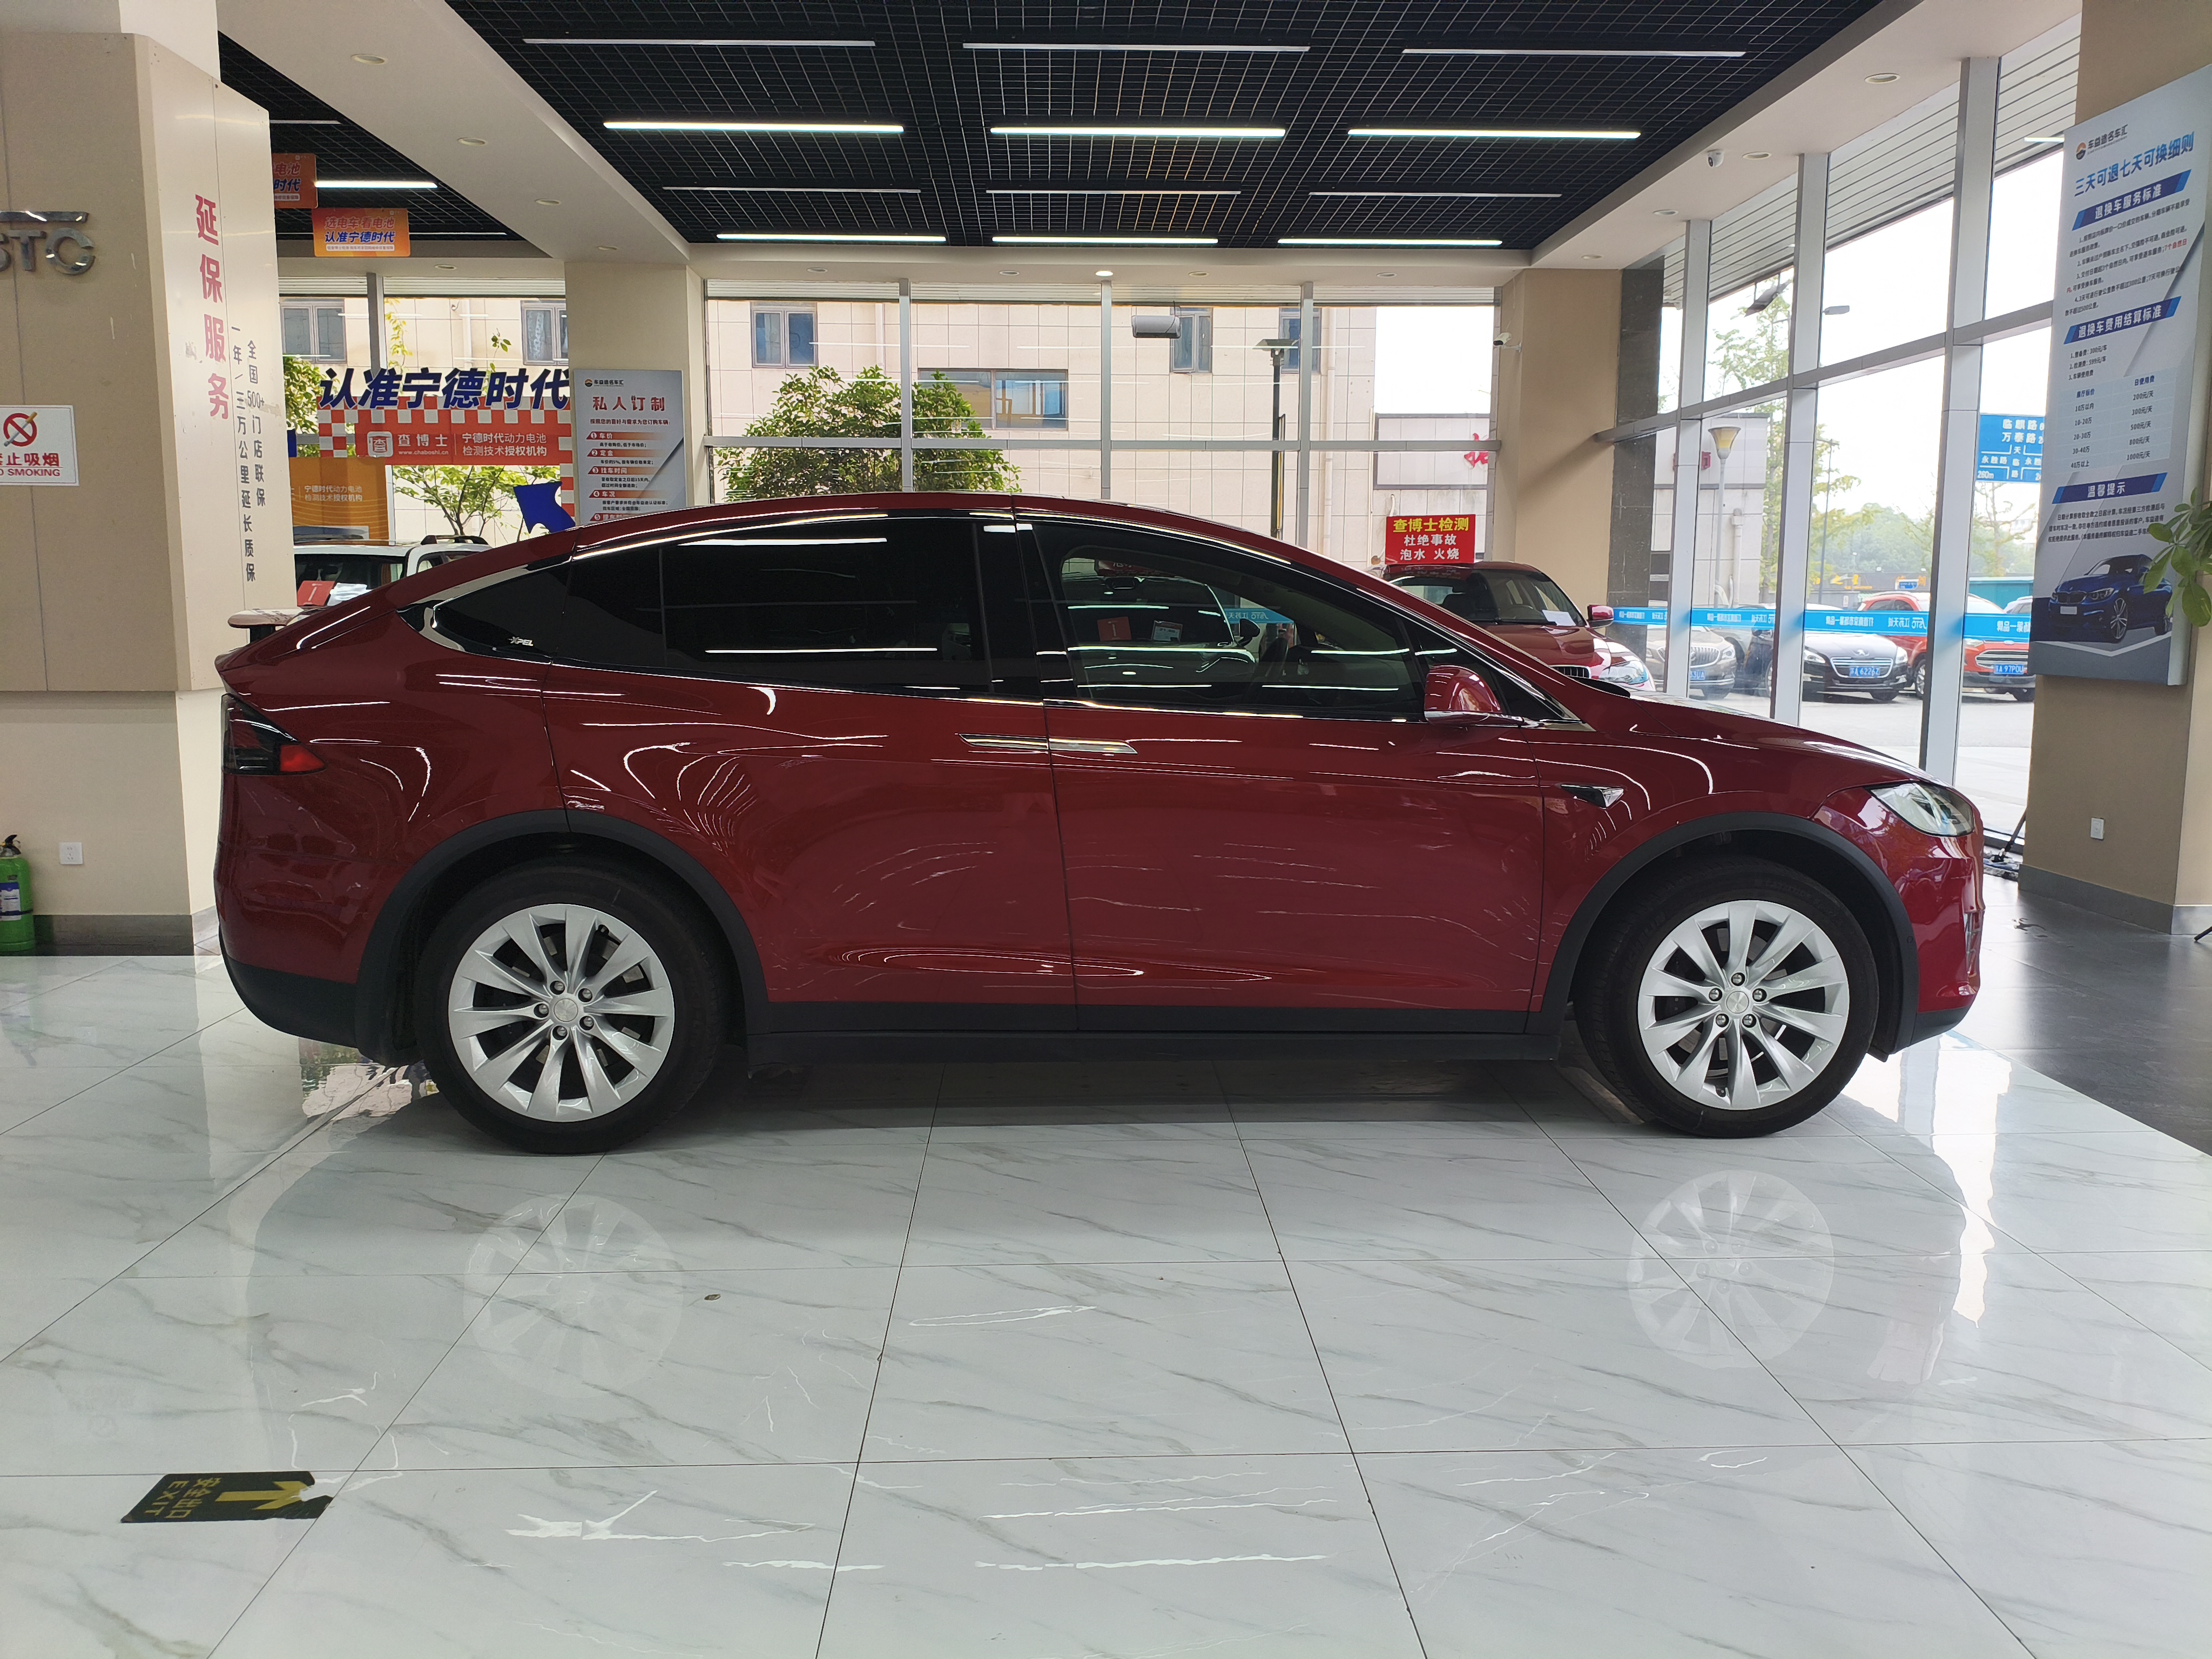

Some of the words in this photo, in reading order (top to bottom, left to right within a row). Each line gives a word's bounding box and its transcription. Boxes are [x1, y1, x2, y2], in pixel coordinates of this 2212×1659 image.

[273, 162, 301, 176] 电池
[2074, 131, 2195, 197] 三天可退七天可换细则
[2095, 184, 2162, 220] 退换车服务标准
[325, 217, 360, 230] 选电车
[361, 217, 395, 230] 看电池
[325, 231, 395, 243] 认准宁德时代
[195, 194, 229, 420] 延保服务
[2078, 305, 2162, 339] 退换车费用结算标准
[319, 368, 570, 410] 认准宁德时代
[592, 396, 665, 412] 私人订制
[398, 434, 448, 447] 查博士
[462, 433, 547, 444] 宁德时代动力电池
[462, 446, 547, 457] 检测技术授权机构
[0, 453, 59, 467] 止吸烟
[304, 485, 362, 493] 宁德时代动力电池
[2087, 482, 2126, 498] 温馨提示
[1393, 517, 1469, 532] 查博士检测
[1404, 534, 1456, 546] 杜绝事故
[1400, 549, 1426, 561] 泡水
[1433, 548, 1459, 560] 火烧
[508, 637, 534, 646] XPEL
[145, 1481, 190, 1516] EXIT
[164, 1478, 221, 1519] 安全出口
